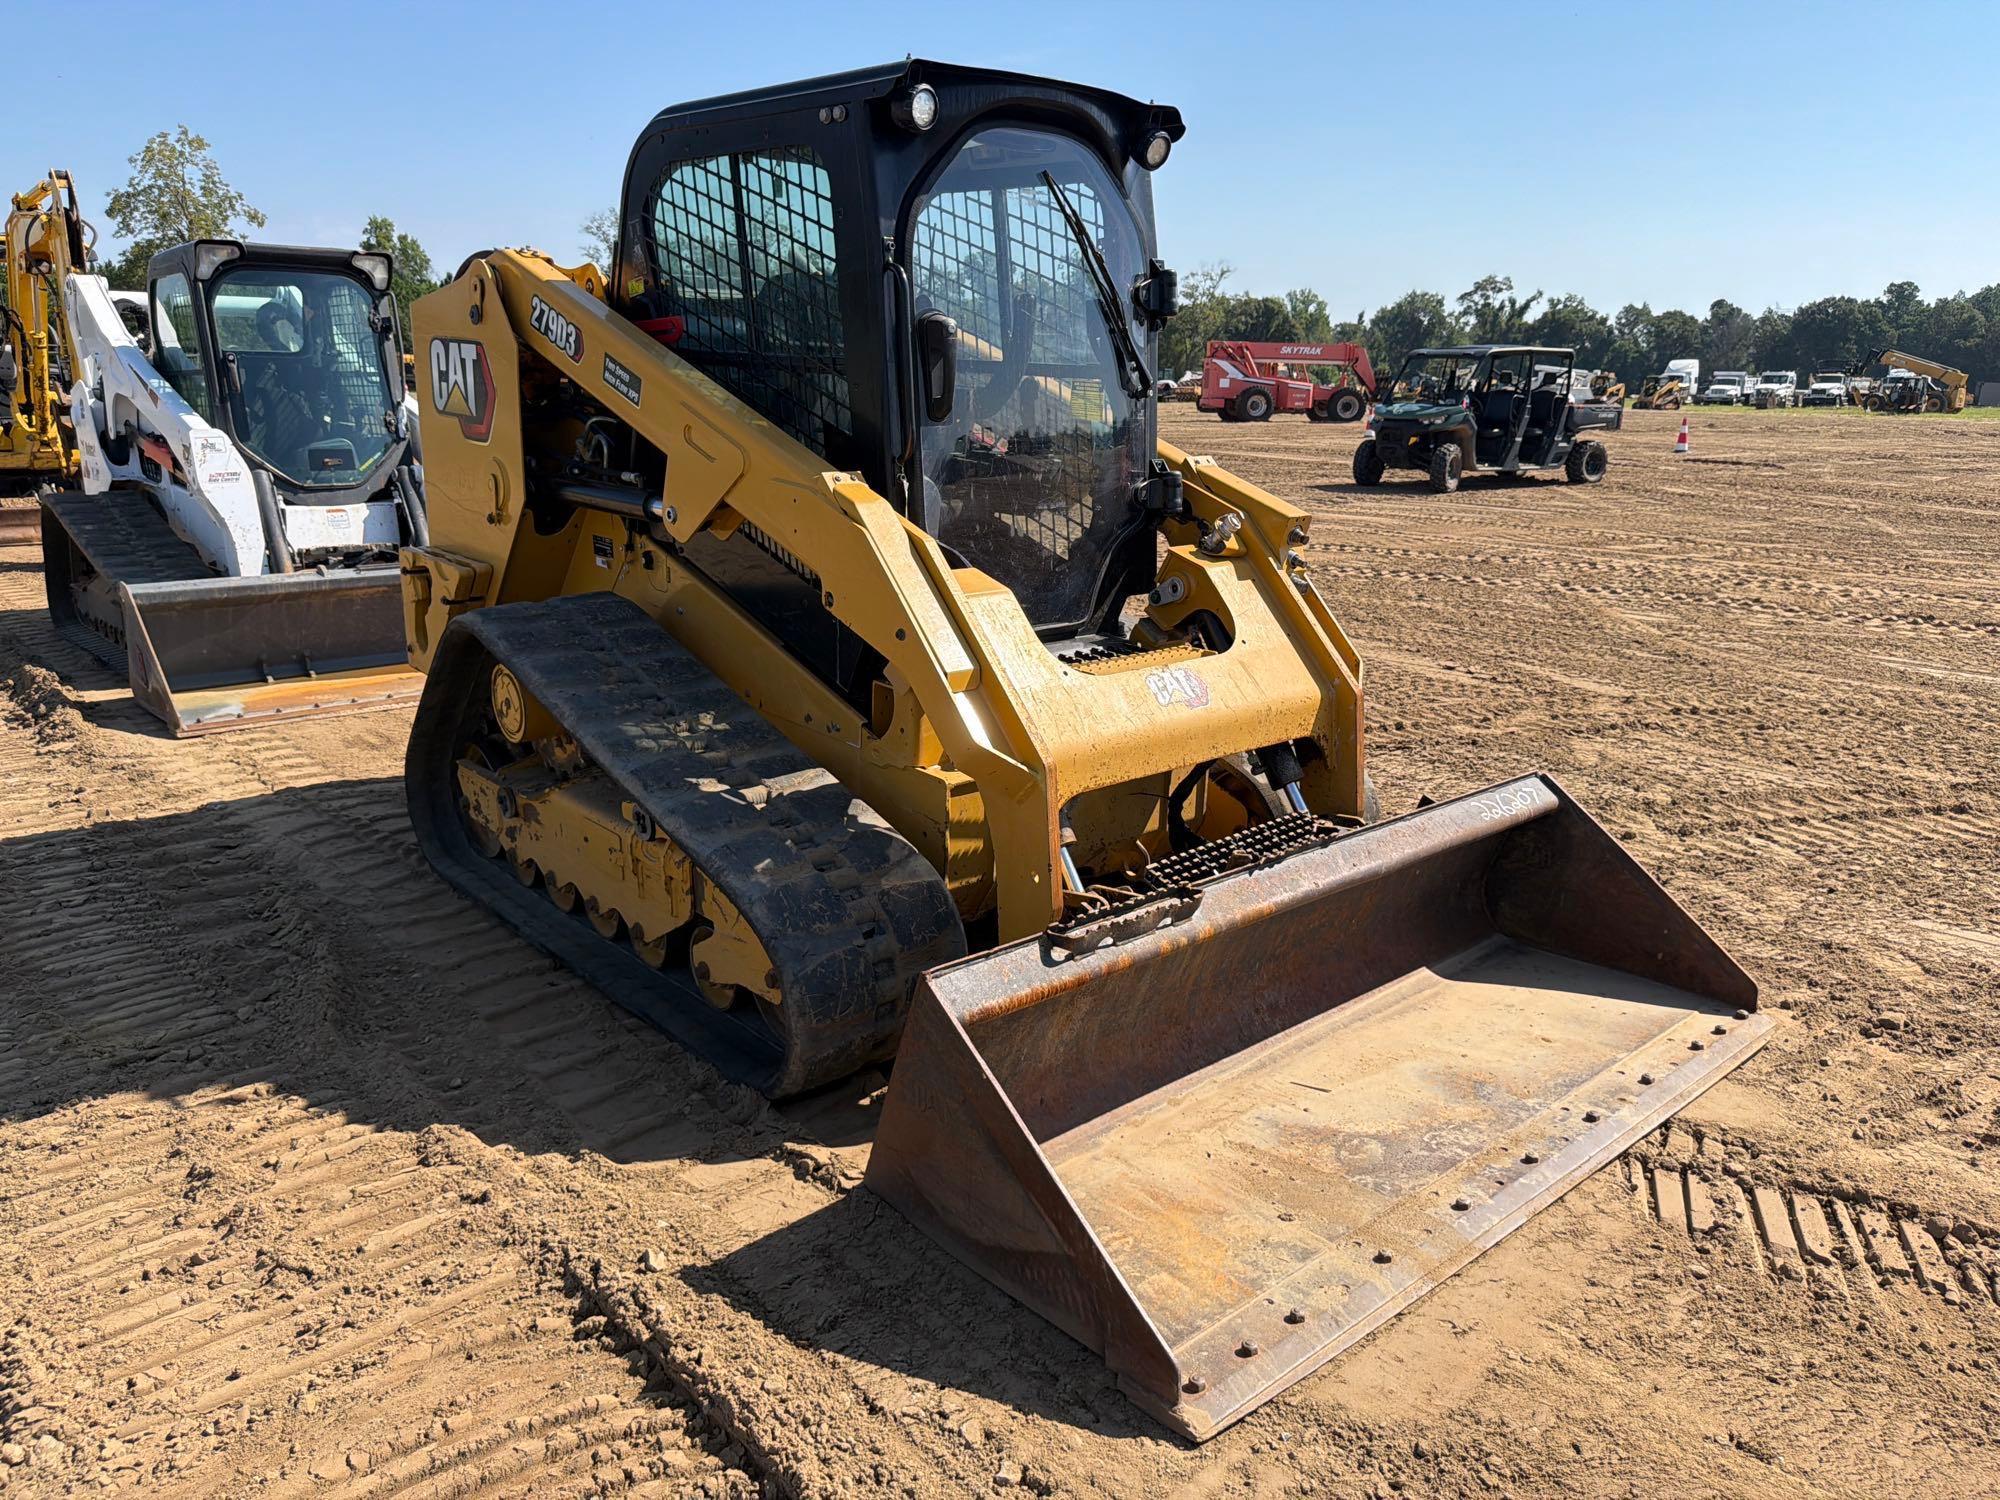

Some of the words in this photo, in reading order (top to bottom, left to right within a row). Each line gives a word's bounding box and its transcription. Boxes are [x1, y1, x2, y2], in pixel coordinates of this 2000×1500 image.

[531, 297, 577, 357] 279D3
[1280, 346, 1323, 355] SKYTRAK
[431, 339, 478, 417] CAT
[1145, 667, 1196, 707] CAT
[1471, 787, 1539, 821] 226207
